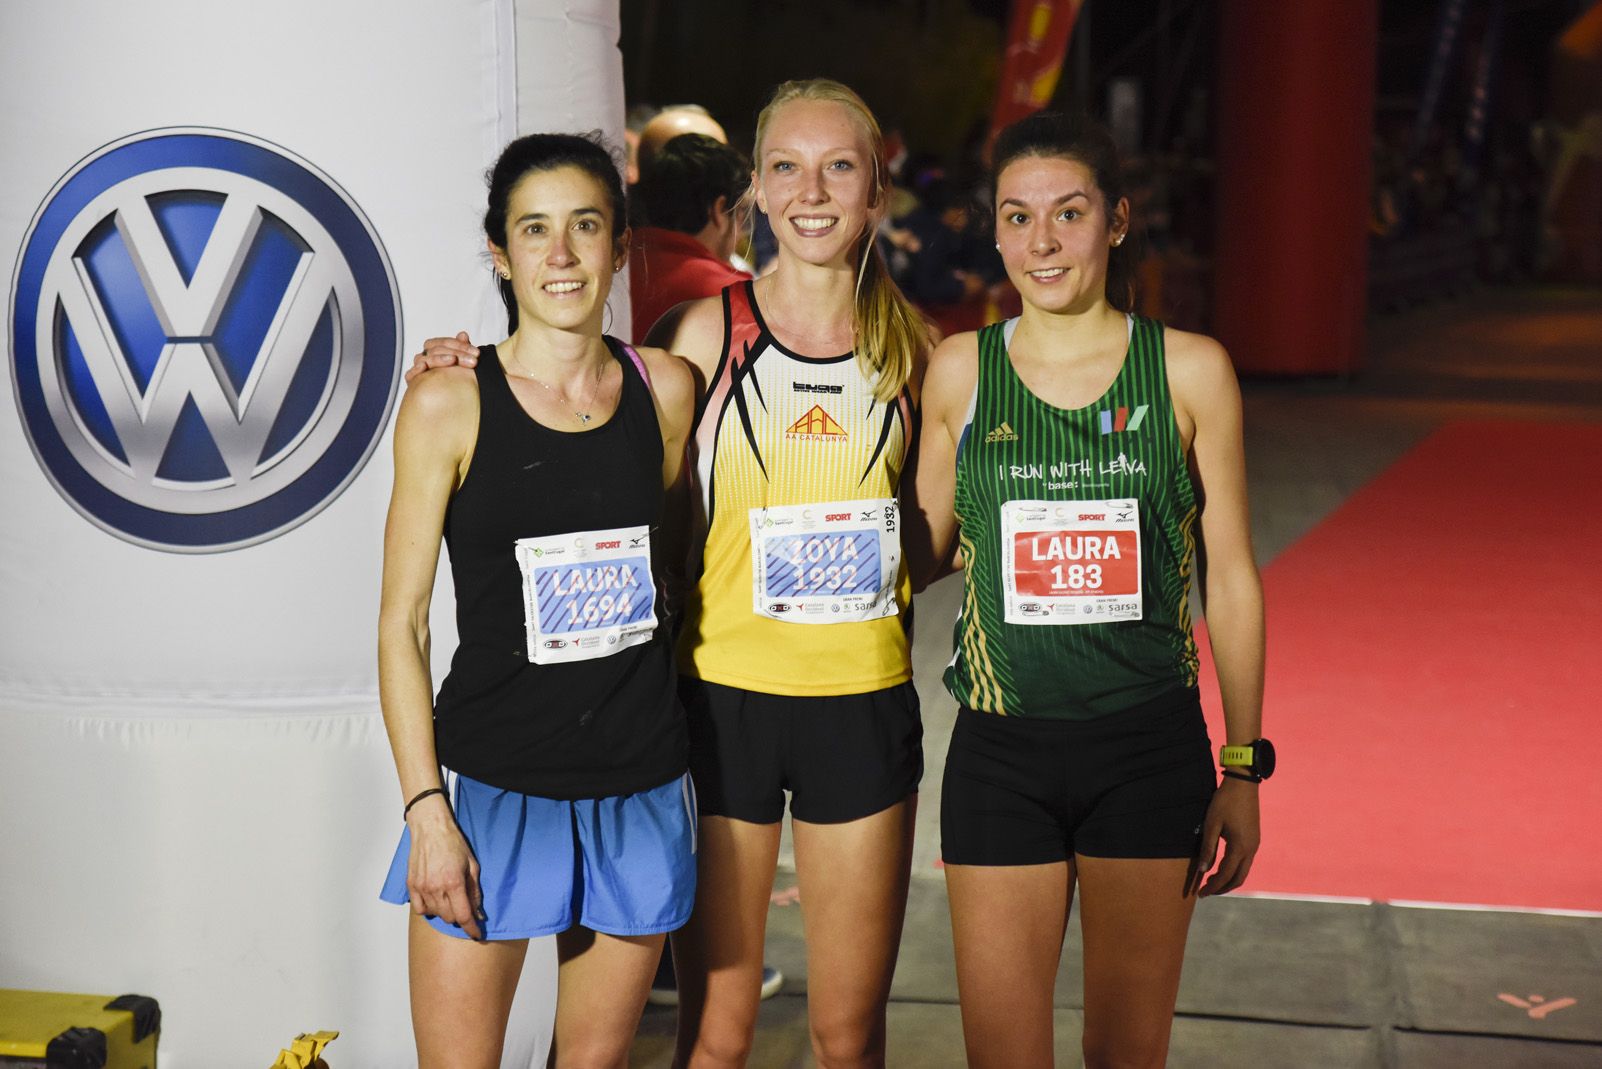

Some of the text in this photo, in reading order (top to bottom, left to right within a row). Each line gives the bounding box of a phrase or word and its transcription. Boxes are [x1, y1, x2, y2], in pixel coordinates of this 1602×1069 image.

[800, 434, 848, 442] CATALUNYA
[985, 433, 1019, 443] adidas
[999, 464, 1004, 480] I
[1010, 464, 1043, 479] RUN
[1050, 459, 1092, 478] WITH
[825, 513, 852, 522] SPORT
[884, 506, 896, 533] 1932
[595, 540, 622, 550] SPORT
[787, 536, 859, 565] ZOYA
[1031, 536, 1121, 561] LAURA
[553, 563, 639, 597] LAURA
[792, 565, 858, 591] 1932
[1050, 564, 1103, 590] 183
[566, 592, 633, 625] 1694
[1108, 603, 1138, 612] sarsa
